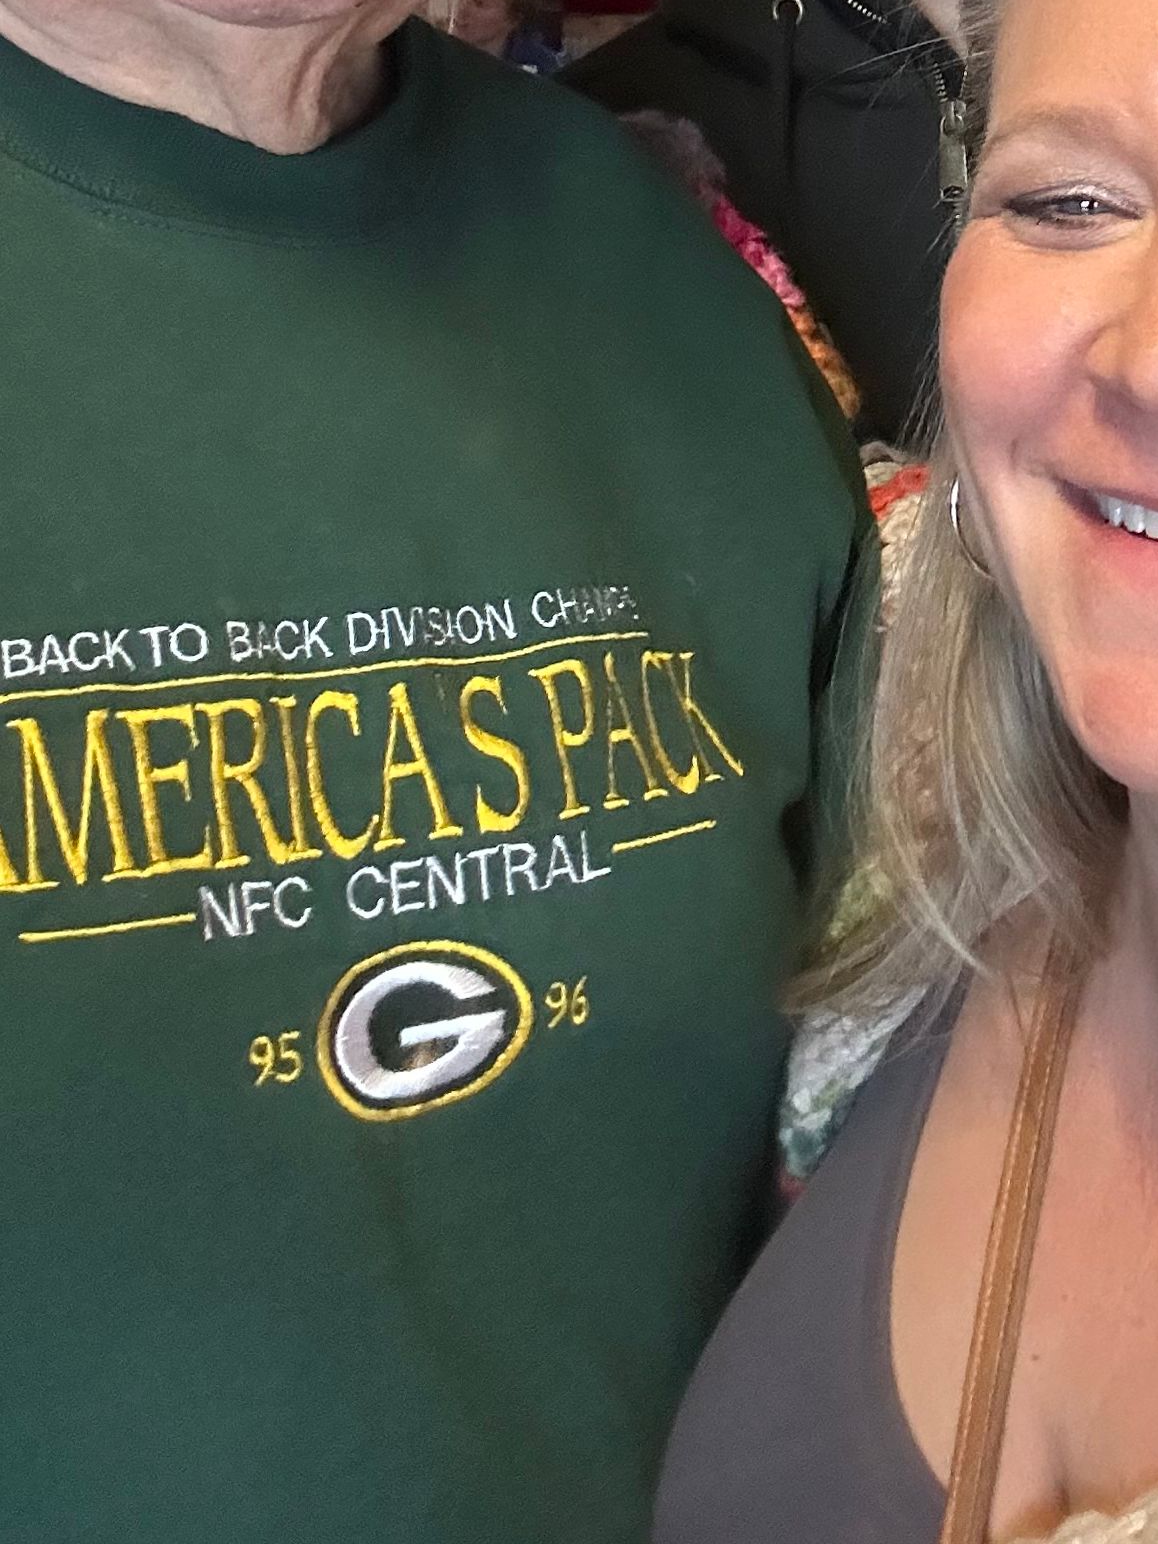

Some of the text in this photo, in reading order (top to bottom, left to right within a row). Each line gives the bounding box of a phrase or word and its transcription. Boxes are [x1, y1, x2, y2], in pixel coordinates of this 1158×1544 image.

[1, 630, 136, 679] BACK
[138, 623, 209, 668] TO
[226, 615, 334, 663] BACK
[347, 598, 518, 656] DIVISION
[528, 650, 744, 820] PACK
[201, 829, 612, 941] NFC CENTRAL
[249, 961, 591, 1100] 95 G 96
